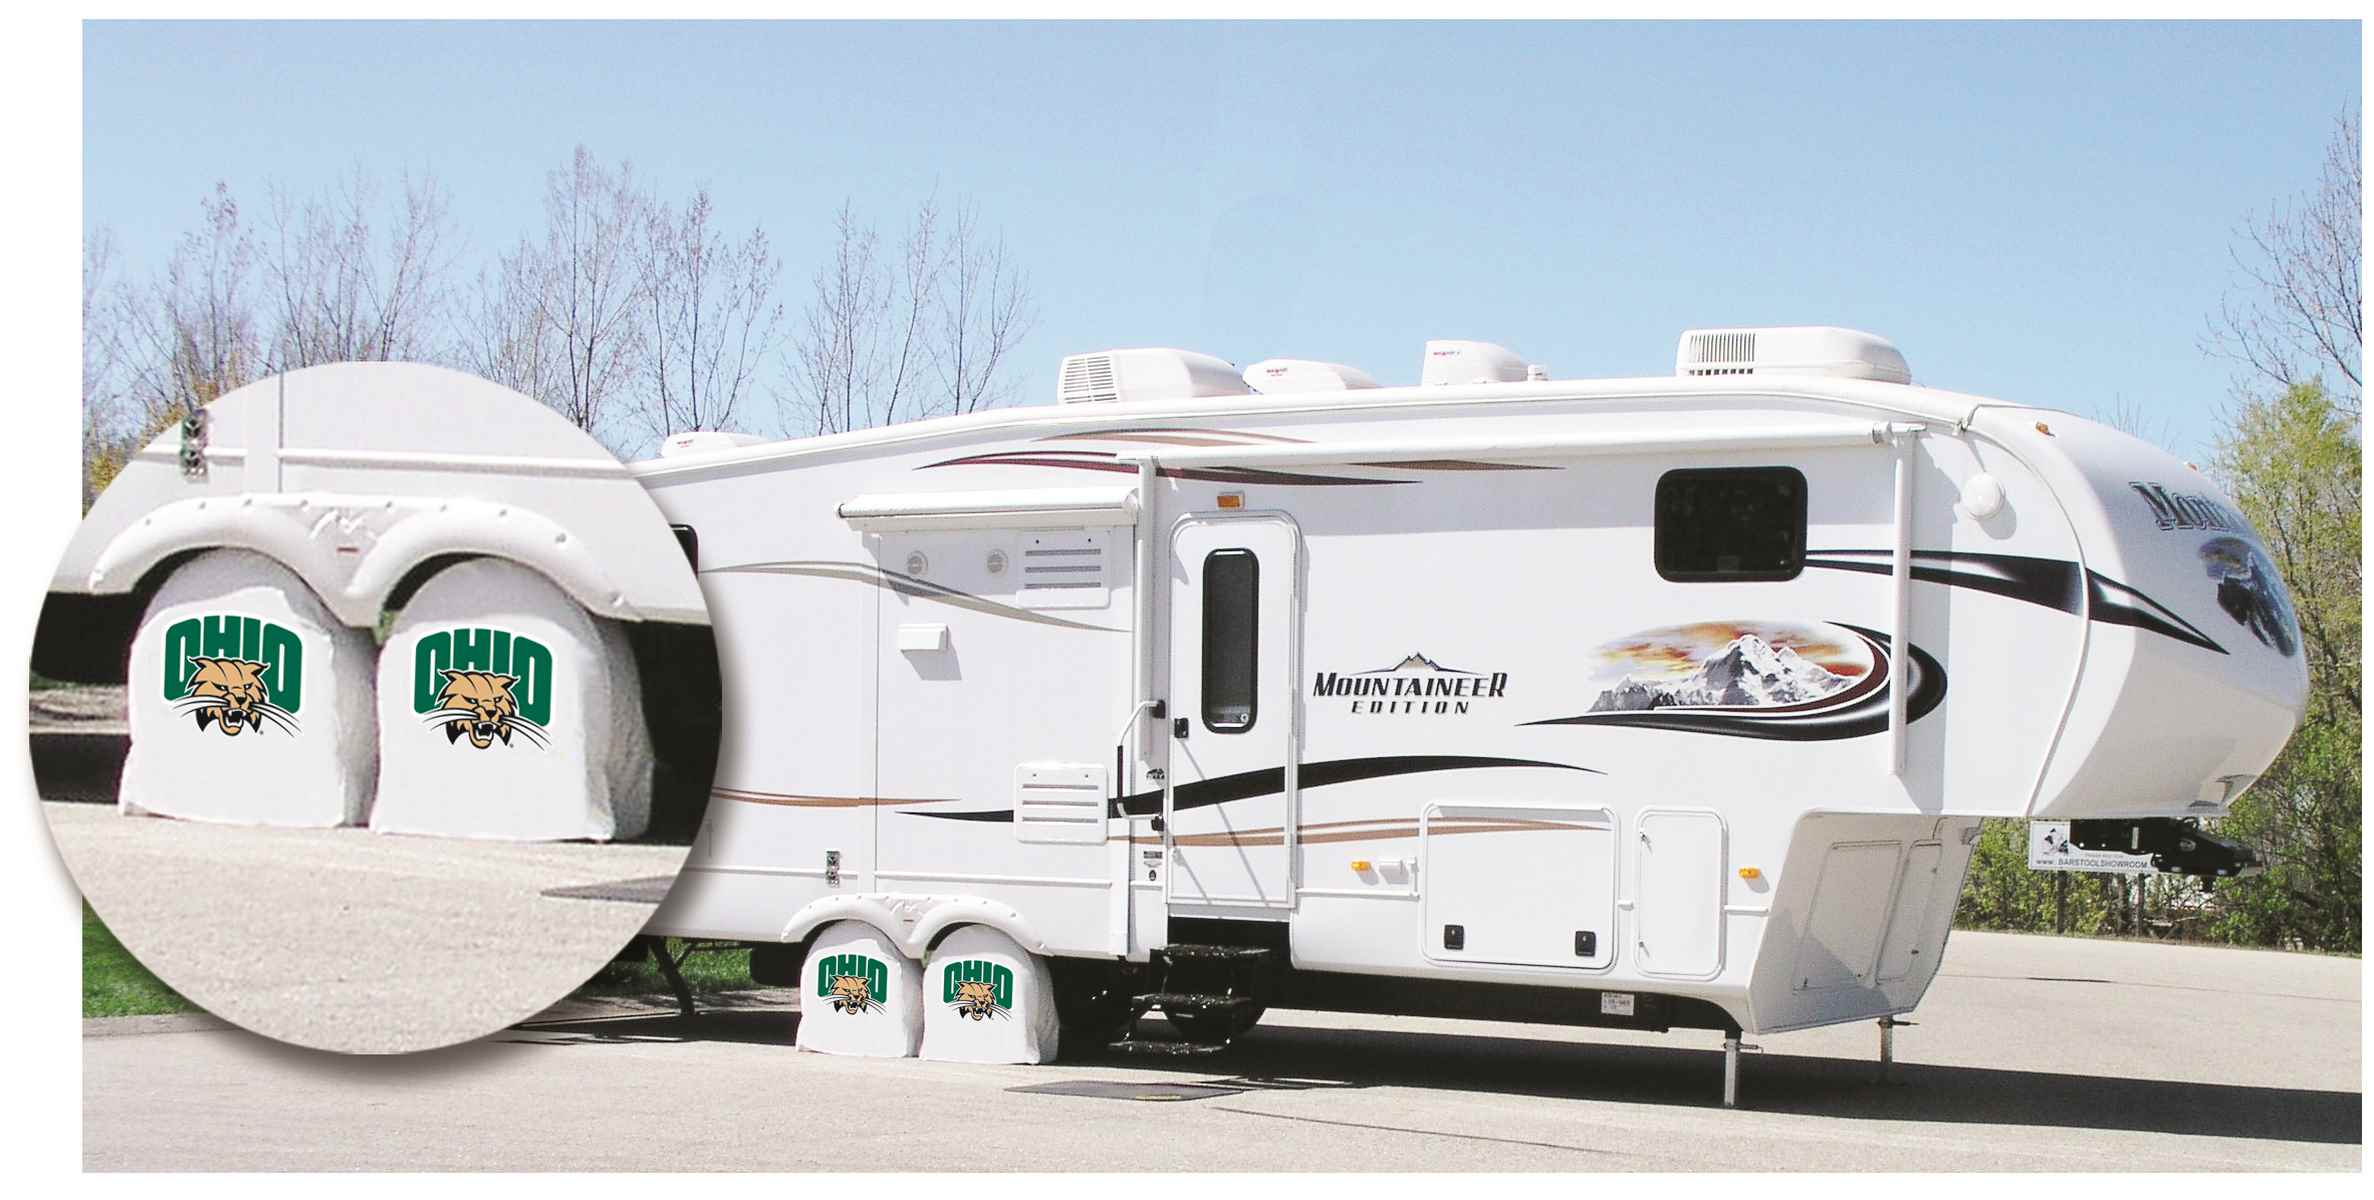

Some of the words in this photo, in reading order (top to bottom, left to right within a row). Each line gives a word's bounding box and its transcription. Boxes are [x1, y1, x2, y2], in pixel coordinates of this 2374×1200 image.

[164, 615, 302, 714] OHIO
[414, 628, 553, 727] OHIO
[1313, 672, 1508, 698] MOUNTAINEER
[1351, 701, 1469, 715] EDITION
[817, 954, 888, 1004] OHIO
[943, 960, 1014, 1010] OHIO
